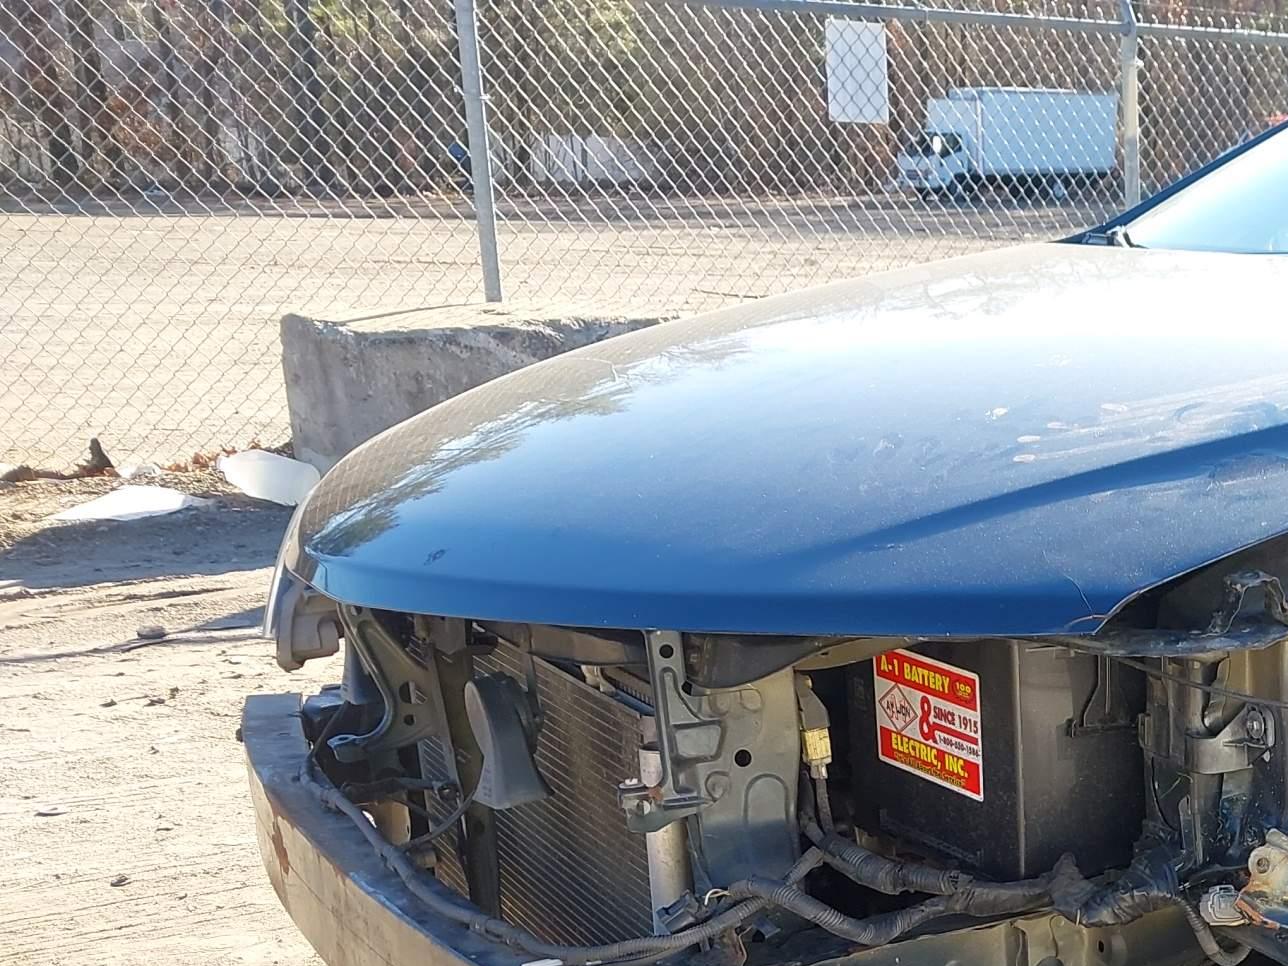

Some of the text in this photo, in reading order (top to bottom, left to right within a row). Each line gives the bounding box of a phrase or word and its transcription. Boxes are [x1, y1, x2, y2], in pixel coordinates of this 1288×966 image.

[881, 655, 949, 694] A-1 BATTERY
[933, 706, 956, 726] SINCE
[958, 715, 979, 734] 1915
[891, 732, 942, 769] ELECTRIC,
[945, 753, 969, 778] INC.
